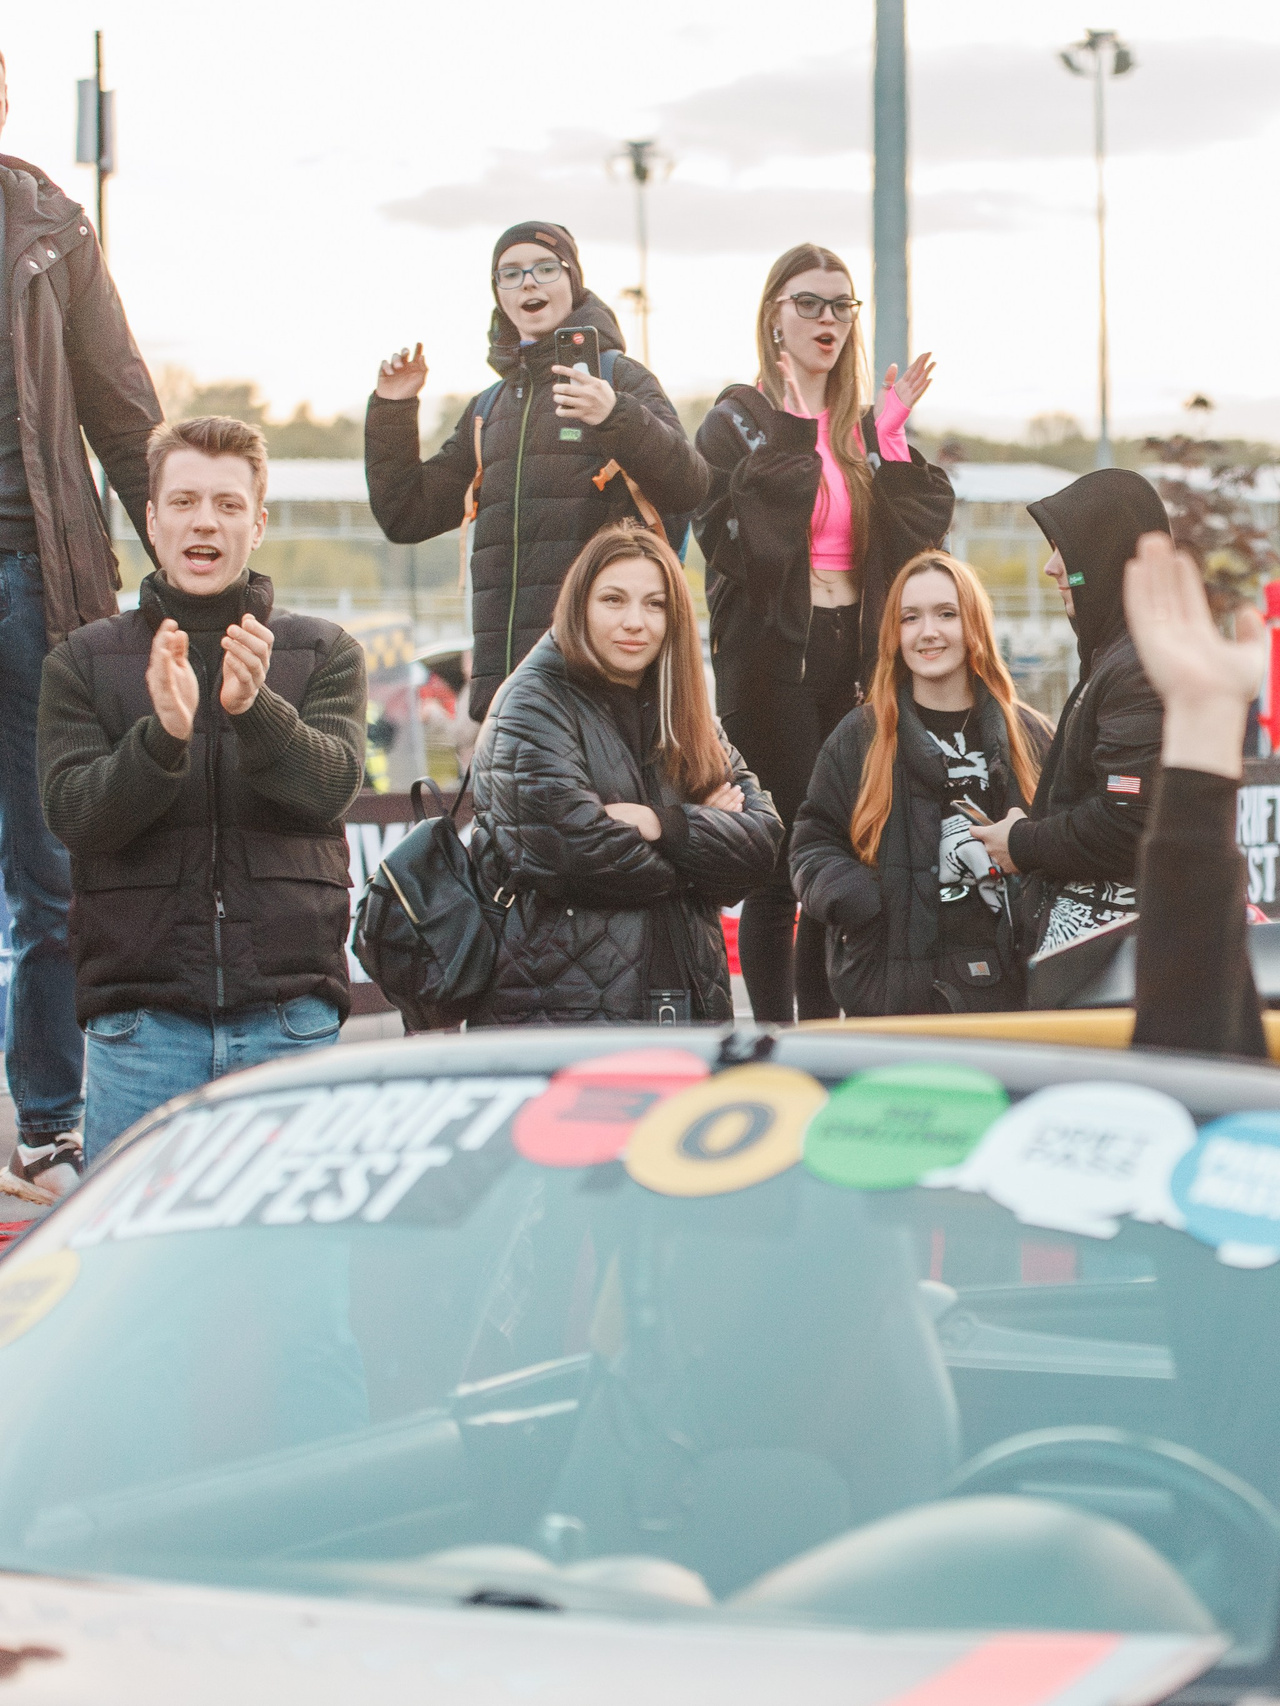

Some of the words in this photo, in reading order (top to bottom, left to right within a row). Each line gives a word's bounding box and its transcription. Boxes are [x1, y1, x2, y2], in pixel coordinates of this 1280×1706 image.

[1247, 845, 1280, 903] ST
[282, 1076, 548, 1155] DRIFT
[229, 1146, 453, 1227] FEST
